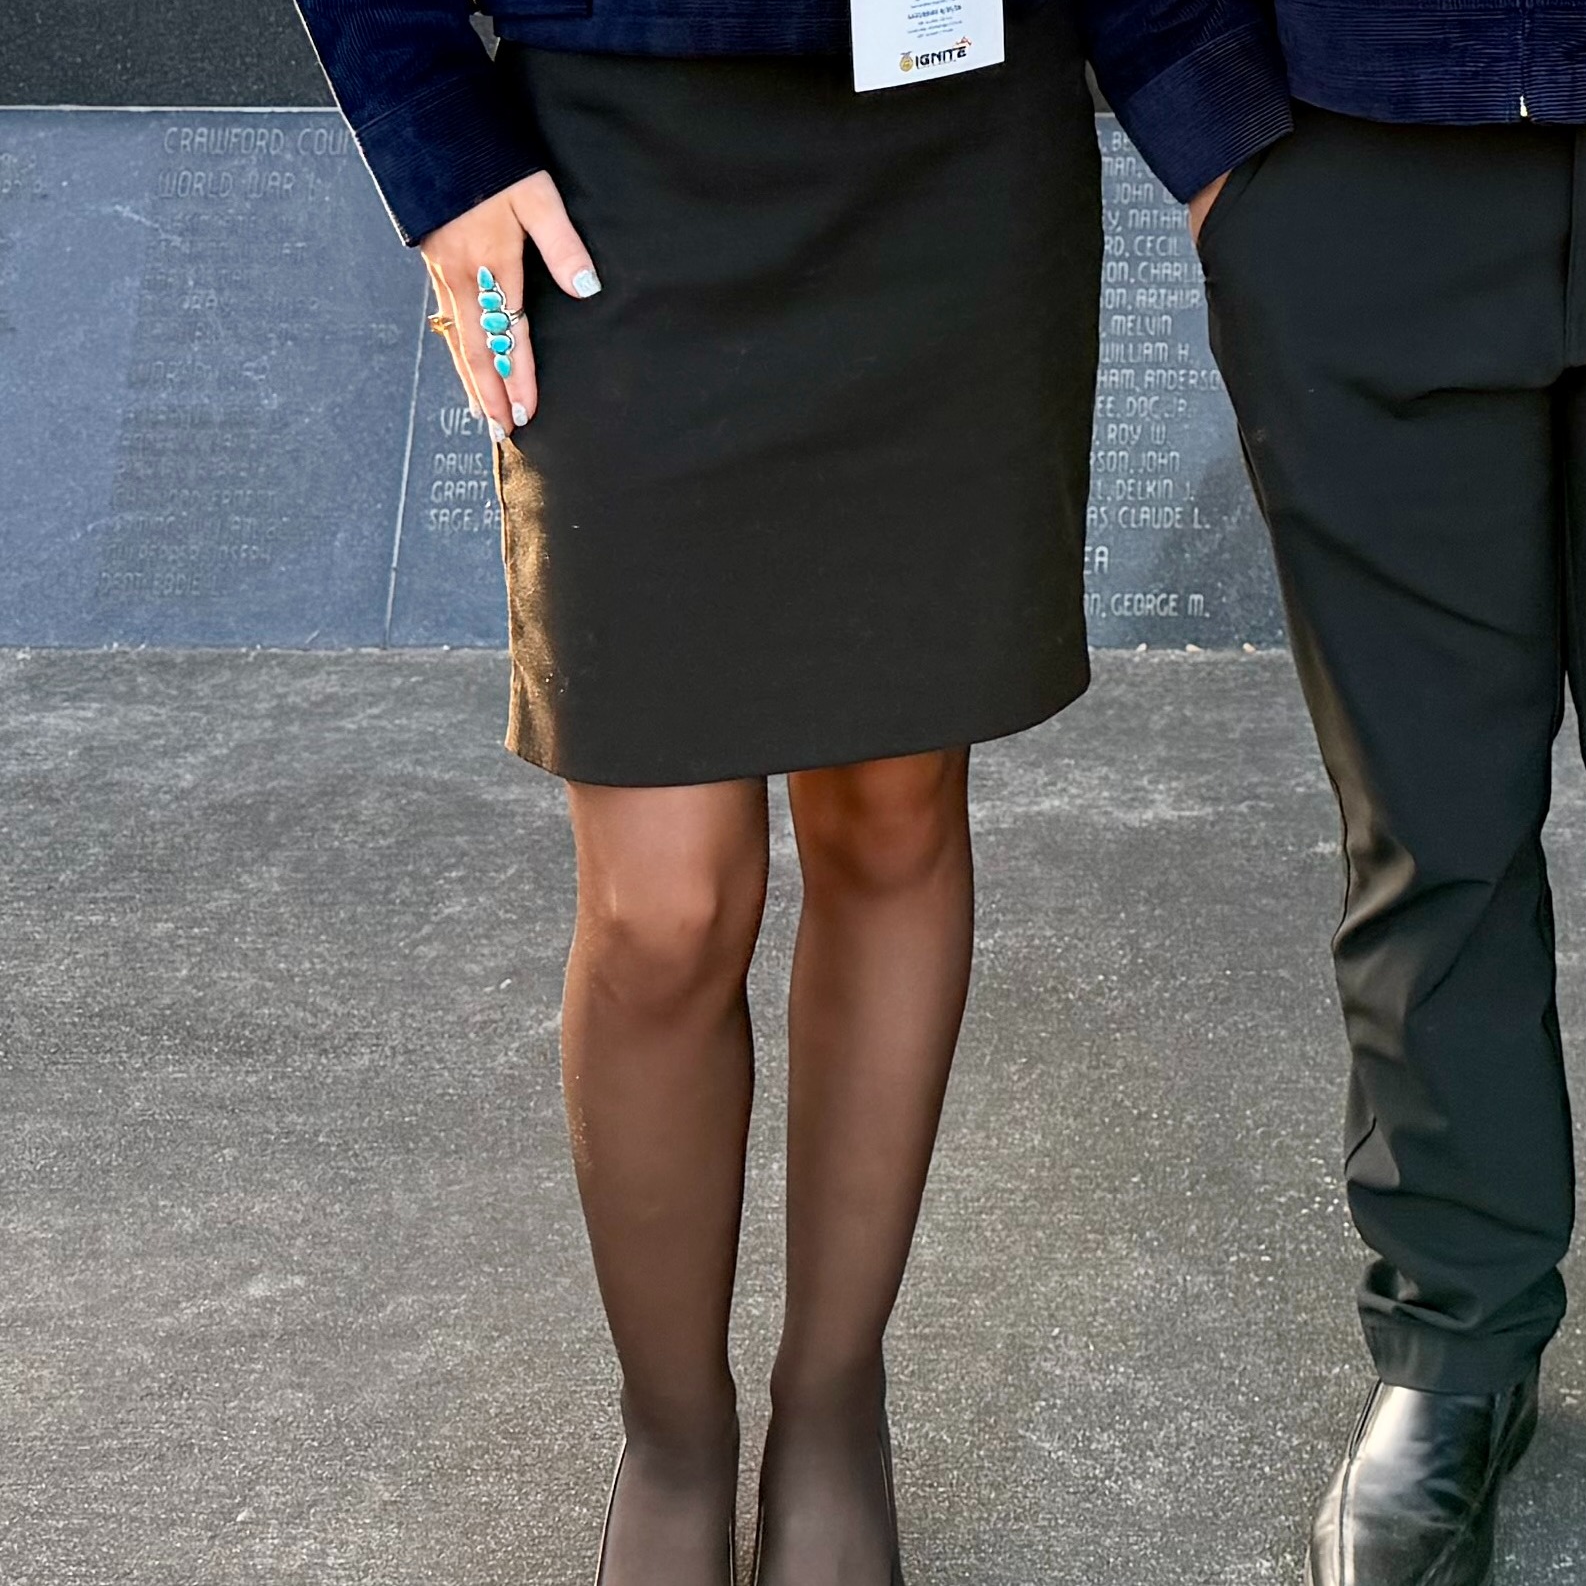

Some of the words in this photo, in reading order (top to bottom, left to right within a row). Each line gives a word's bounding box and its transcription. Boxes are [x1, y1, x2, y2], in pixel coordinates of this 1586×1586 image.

[915, 45, 967, 70] IGNITE
[163, 126, 284, 156] CRAWFORD
[157, 169, 234, 199] WORLD
[246, 169, 297, 199] WAR
[1112, 182, 1154, 205] JOHN
[1134, 235, 1180, 257] CECIL
[1135, 287, 1201, 310] ARTHUR
[1111, 314, 1173, 337] MELVIN
[1107, 423, 1143, 446] ROY
[1138, 450, 1180, 473] JOHN
[1116, 478, 1174, 502] DELKIN
[1118, 505, 1184, 530] CLAUDE
[1110, 592, 1179, 618] GEORGE
